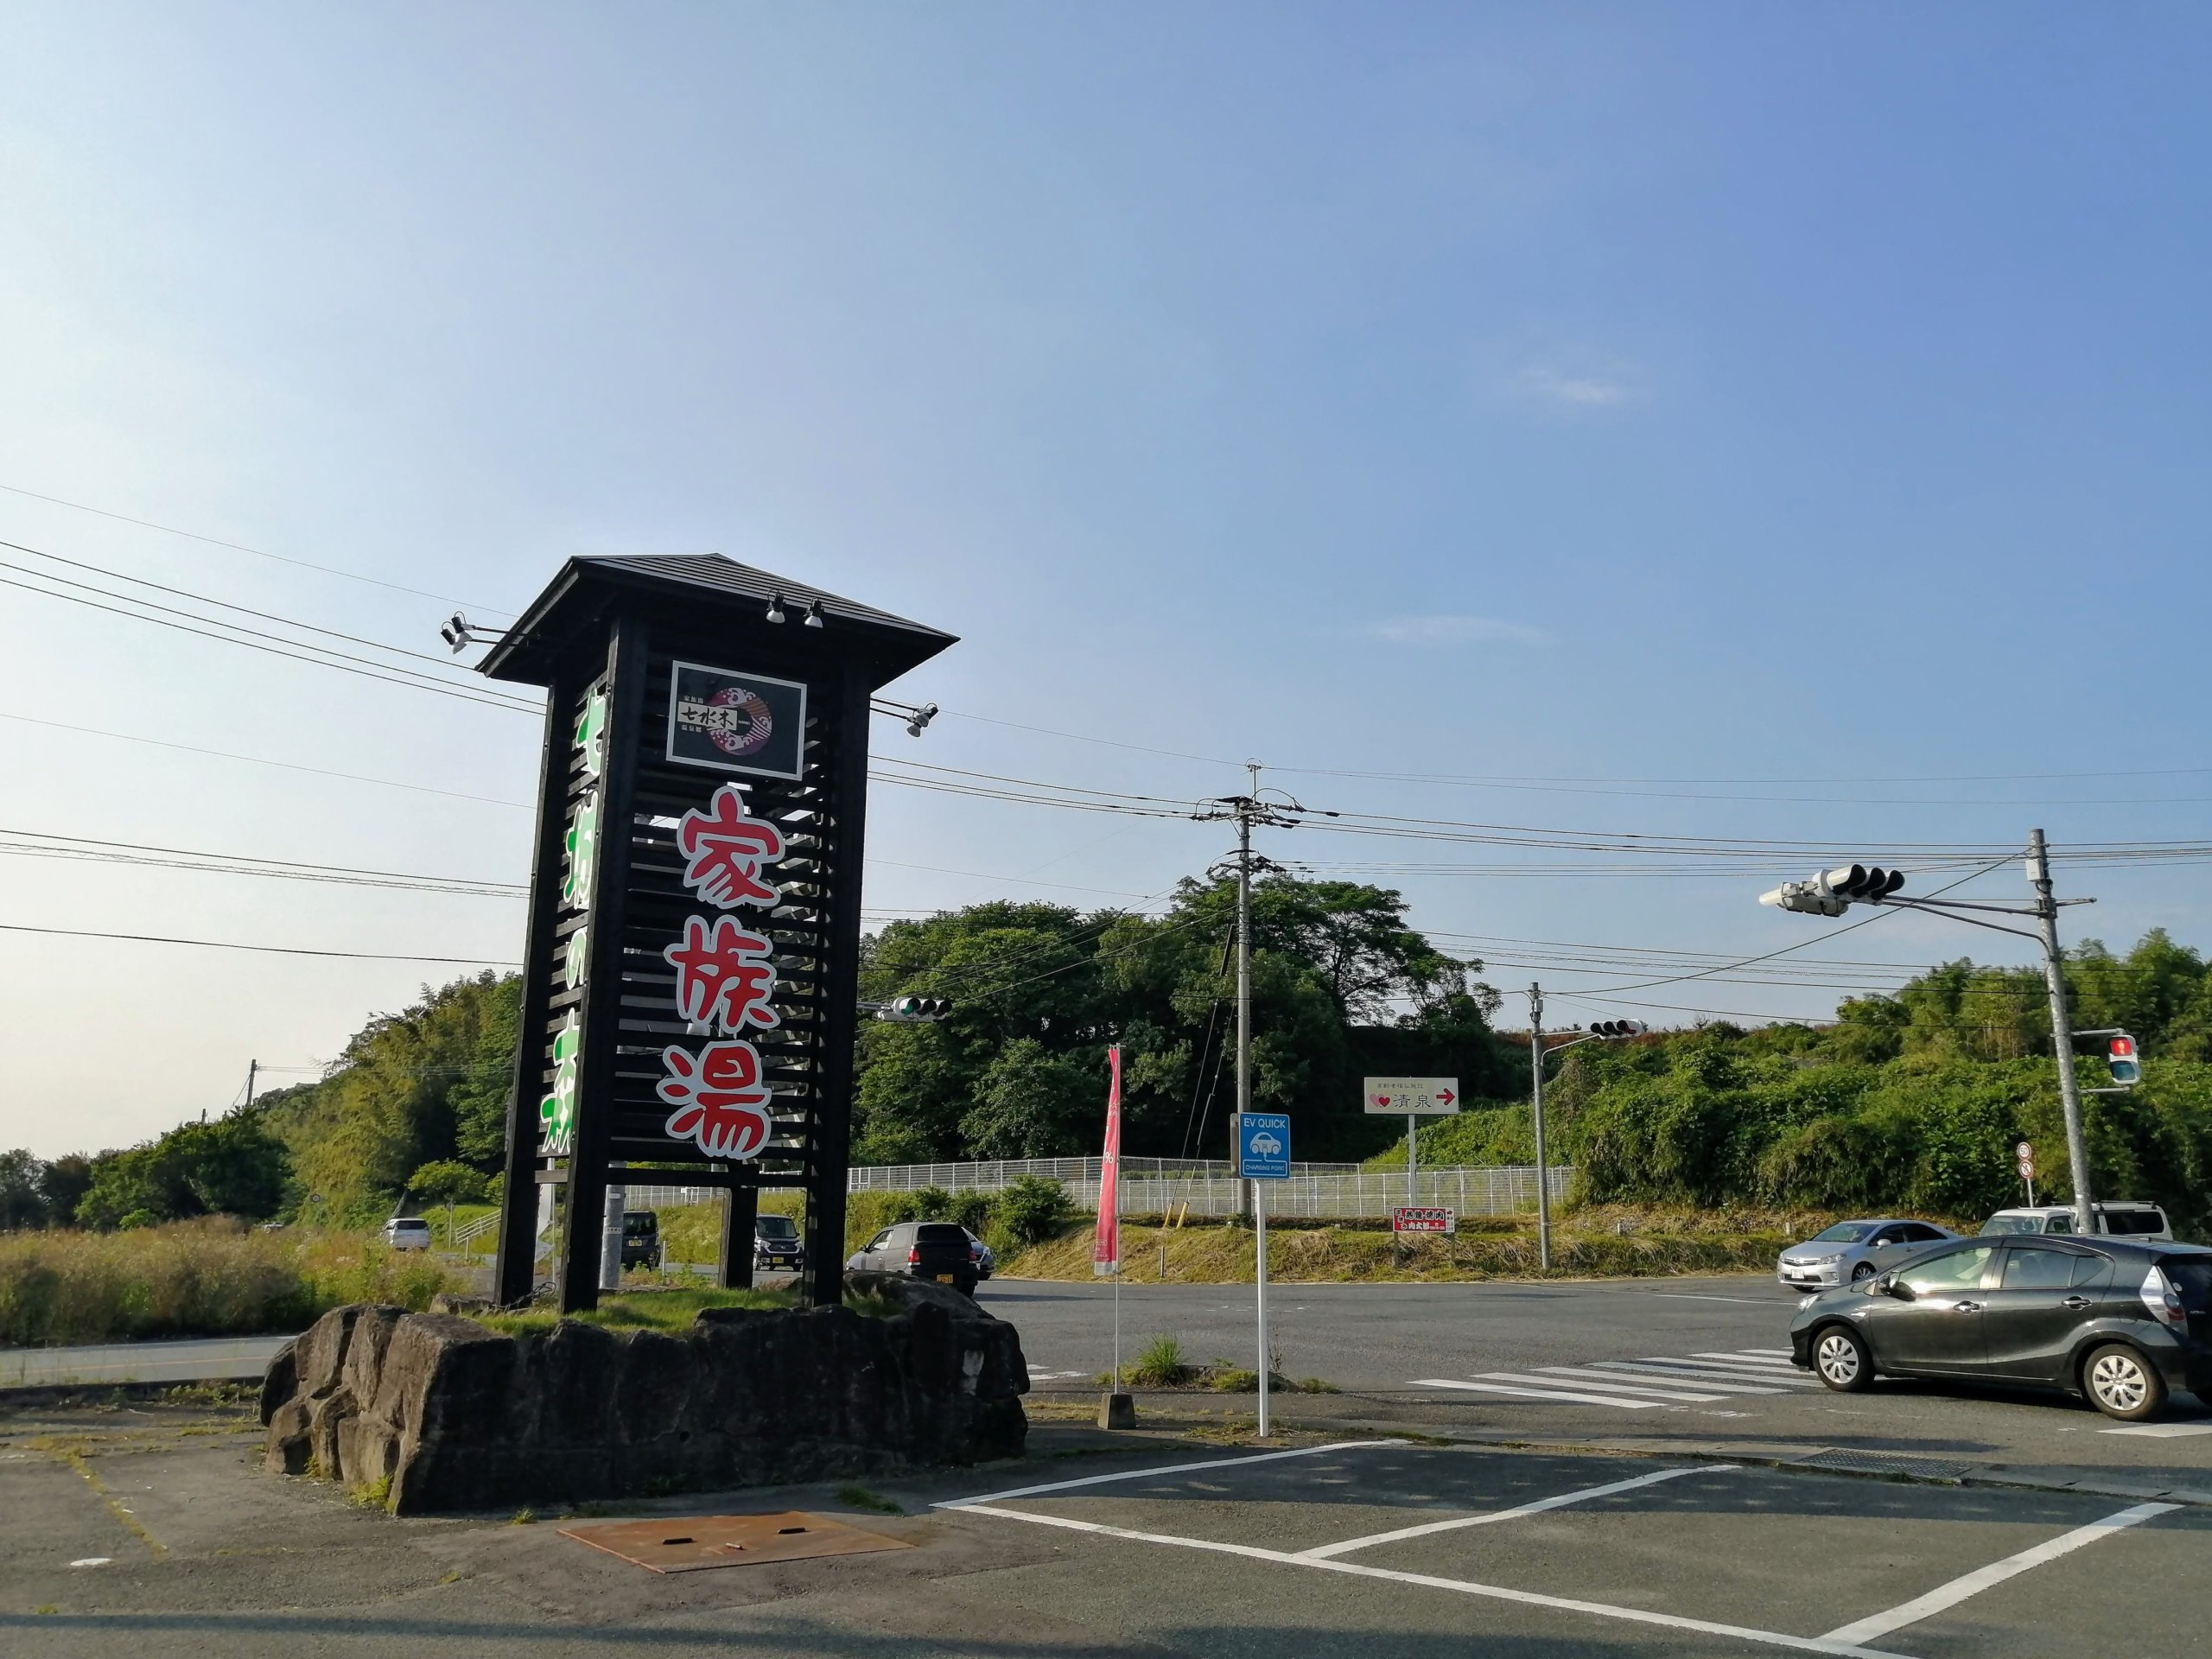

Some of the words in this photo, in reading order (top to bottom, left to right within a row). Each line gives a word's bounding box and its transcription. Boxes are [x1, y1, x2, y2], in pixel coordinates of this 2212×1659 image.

[681, 706, 734, 728] 七水木
[657, 786, 785, 1159] 家族湯
[1393, 1093, 1432, 1108] 清泉
[1243, 1117, 1256, 1128] EV
[1257, 1118, 1286, 1128] QUICK
